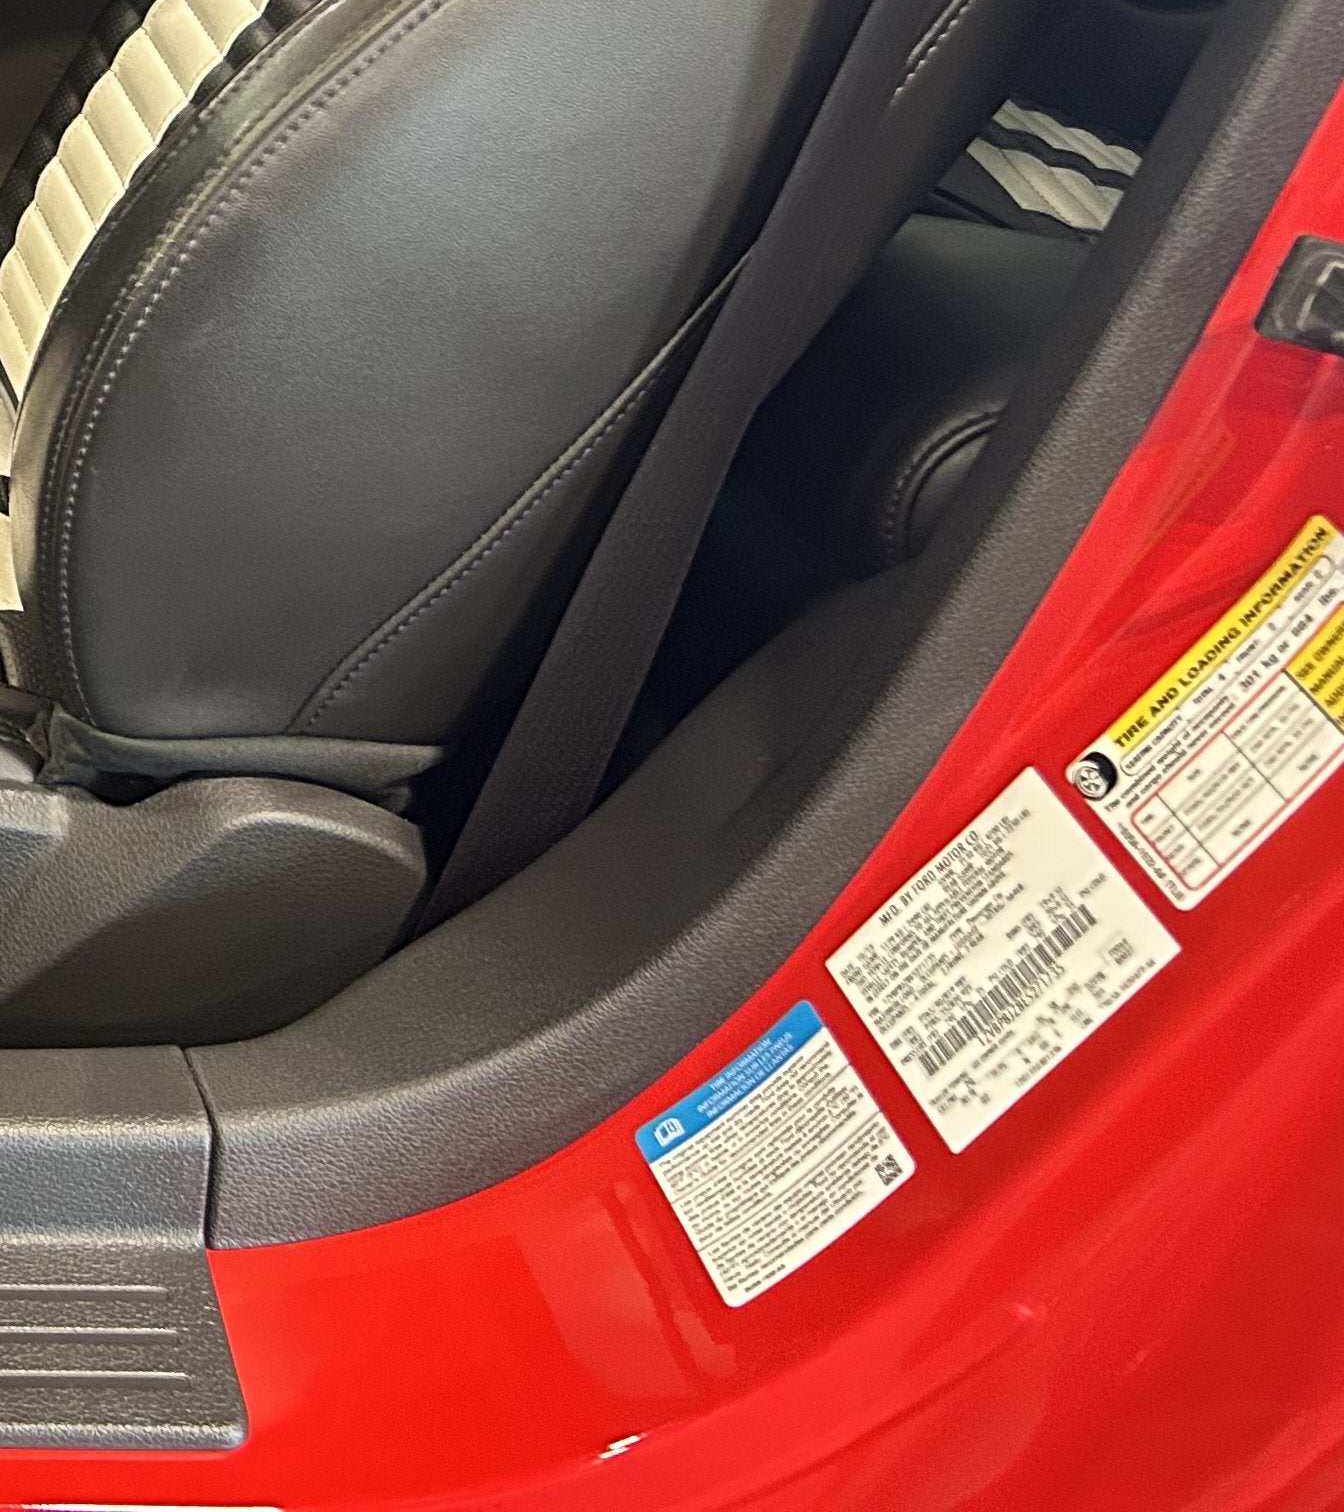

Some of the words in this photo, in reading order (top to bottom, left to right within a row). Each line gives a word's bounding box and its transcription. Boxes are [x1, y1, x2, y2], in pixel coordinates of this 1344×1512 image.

[1113, 714, 1150, 749] TIRE
[1146, 684, 1181, 718] AND
[1176, 624, 1242, 688] LOADING
[1238, 525, 1330, 628] INFORMATION
[898, 890, 914, 907] BY
[909, 868, 938, 896] FORD
[932, 840, 968, 874] MOTOR
